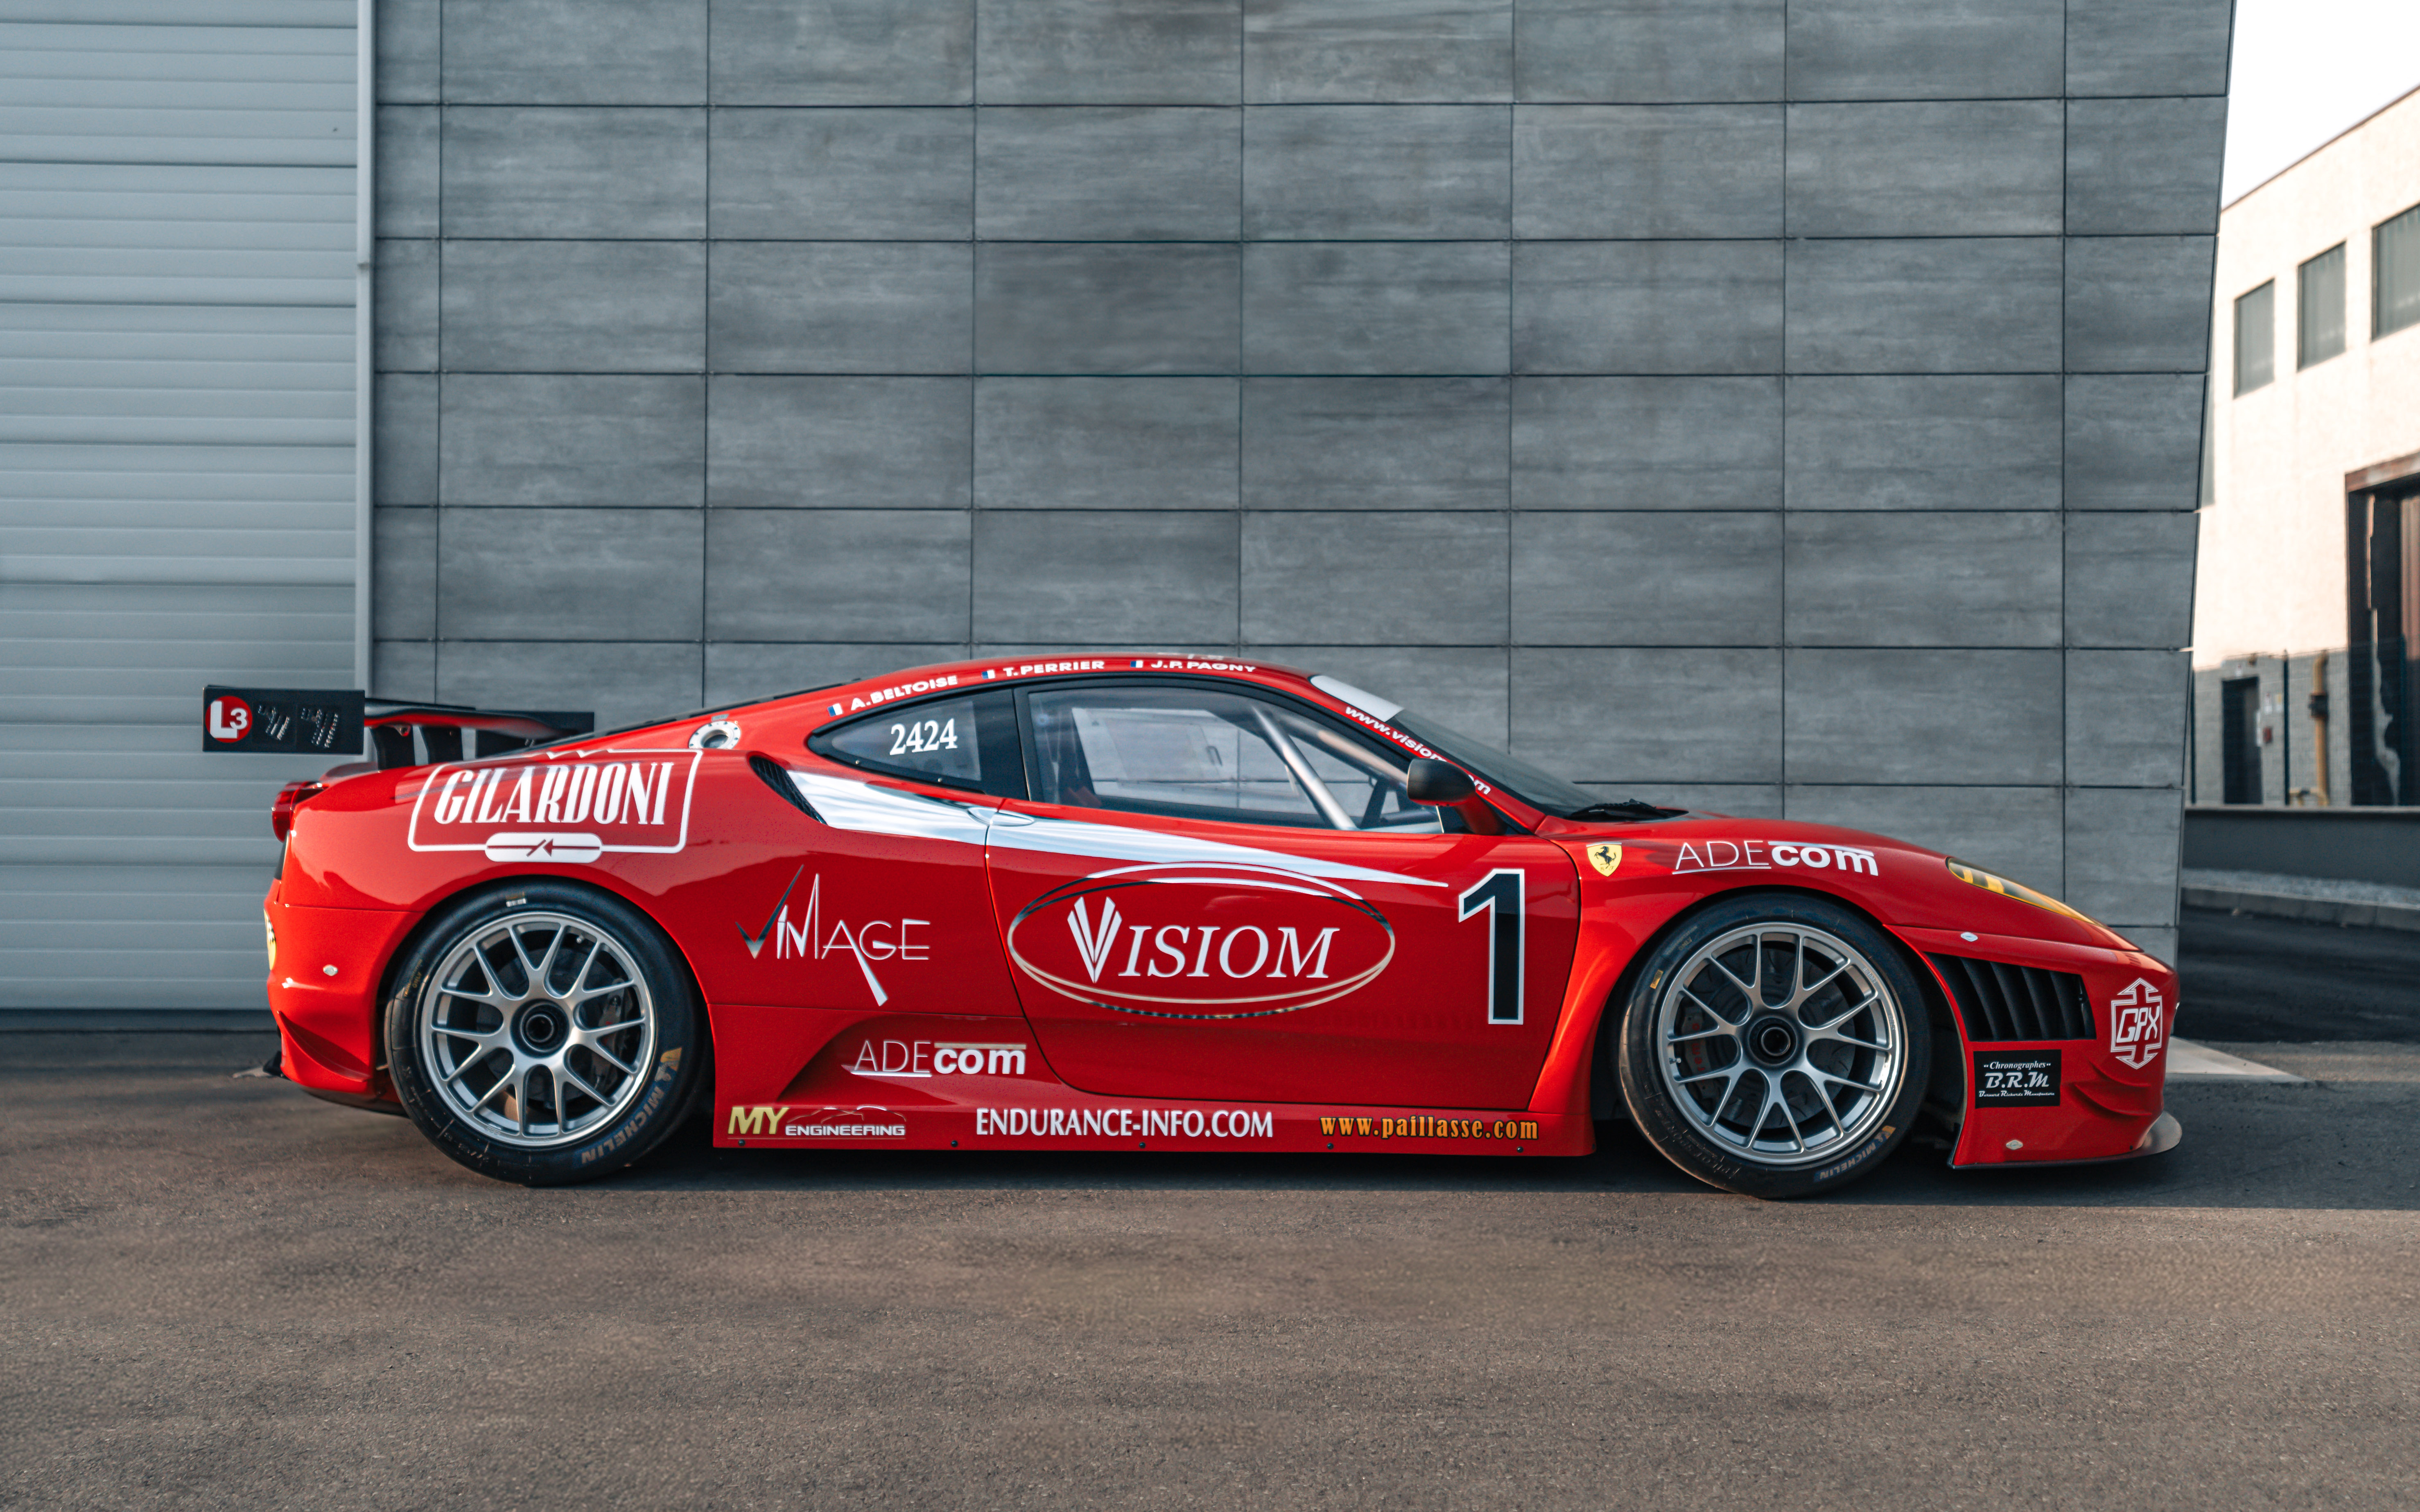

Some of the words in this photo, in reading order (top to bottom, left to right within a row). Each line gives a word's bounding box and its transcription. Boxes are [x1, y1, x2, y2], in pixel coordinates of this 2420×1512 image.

[851, 675, 958, 711] A.BELTOISE
[210, 700, 248, 738] L3
[890, 718, 958, 756] 2424
[434, 762, 674, 825] GILARDONI
[1675, 840, 1879, 876] ADEcom
[1459, 868, 1525, 1025] 1
[2116, 1005, 2160, 1043] GPX
[854, 1040, 1026, 1075] ADEcom
[581, 1086, 664, 1164] MICHELIN
[728, 1106, 790, 1135] MY
[785, 1125, 905, 1136] ENGINEERING
[976, 1108, 1273, 1138] ENDURANCE-INFO.COM
[1319, 1115, 1539, 1140] www.paillasse.com
[1819, 1142, 1876, 1180] MICHELIN
